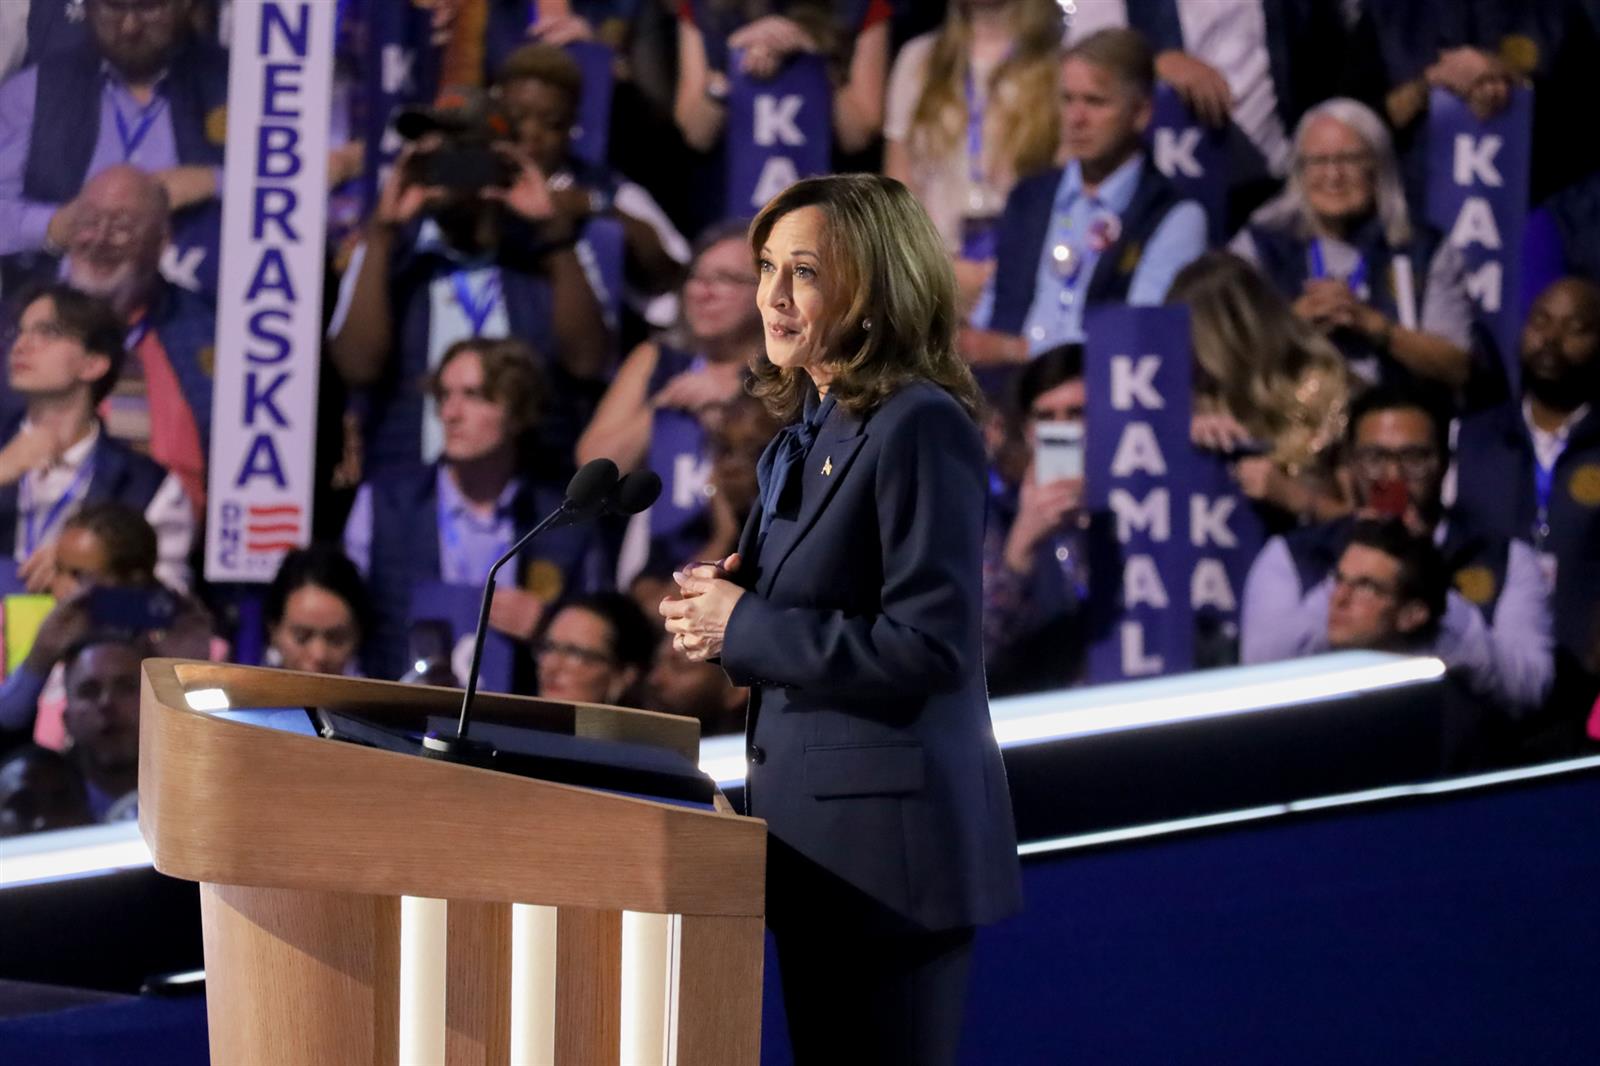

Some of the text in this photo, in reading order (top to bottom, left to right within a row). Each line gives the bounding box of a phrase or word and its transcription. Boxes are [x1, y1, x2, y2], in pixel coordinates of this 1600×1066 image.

[1153, 127, 1205, 178] K
[235, 3, 309, 489] NEBRASKA
[220, 503, 241, 569] DNC
[1109, 354, 1168, 677] KAMAL
[1190, 493, 1239, 611] KA
